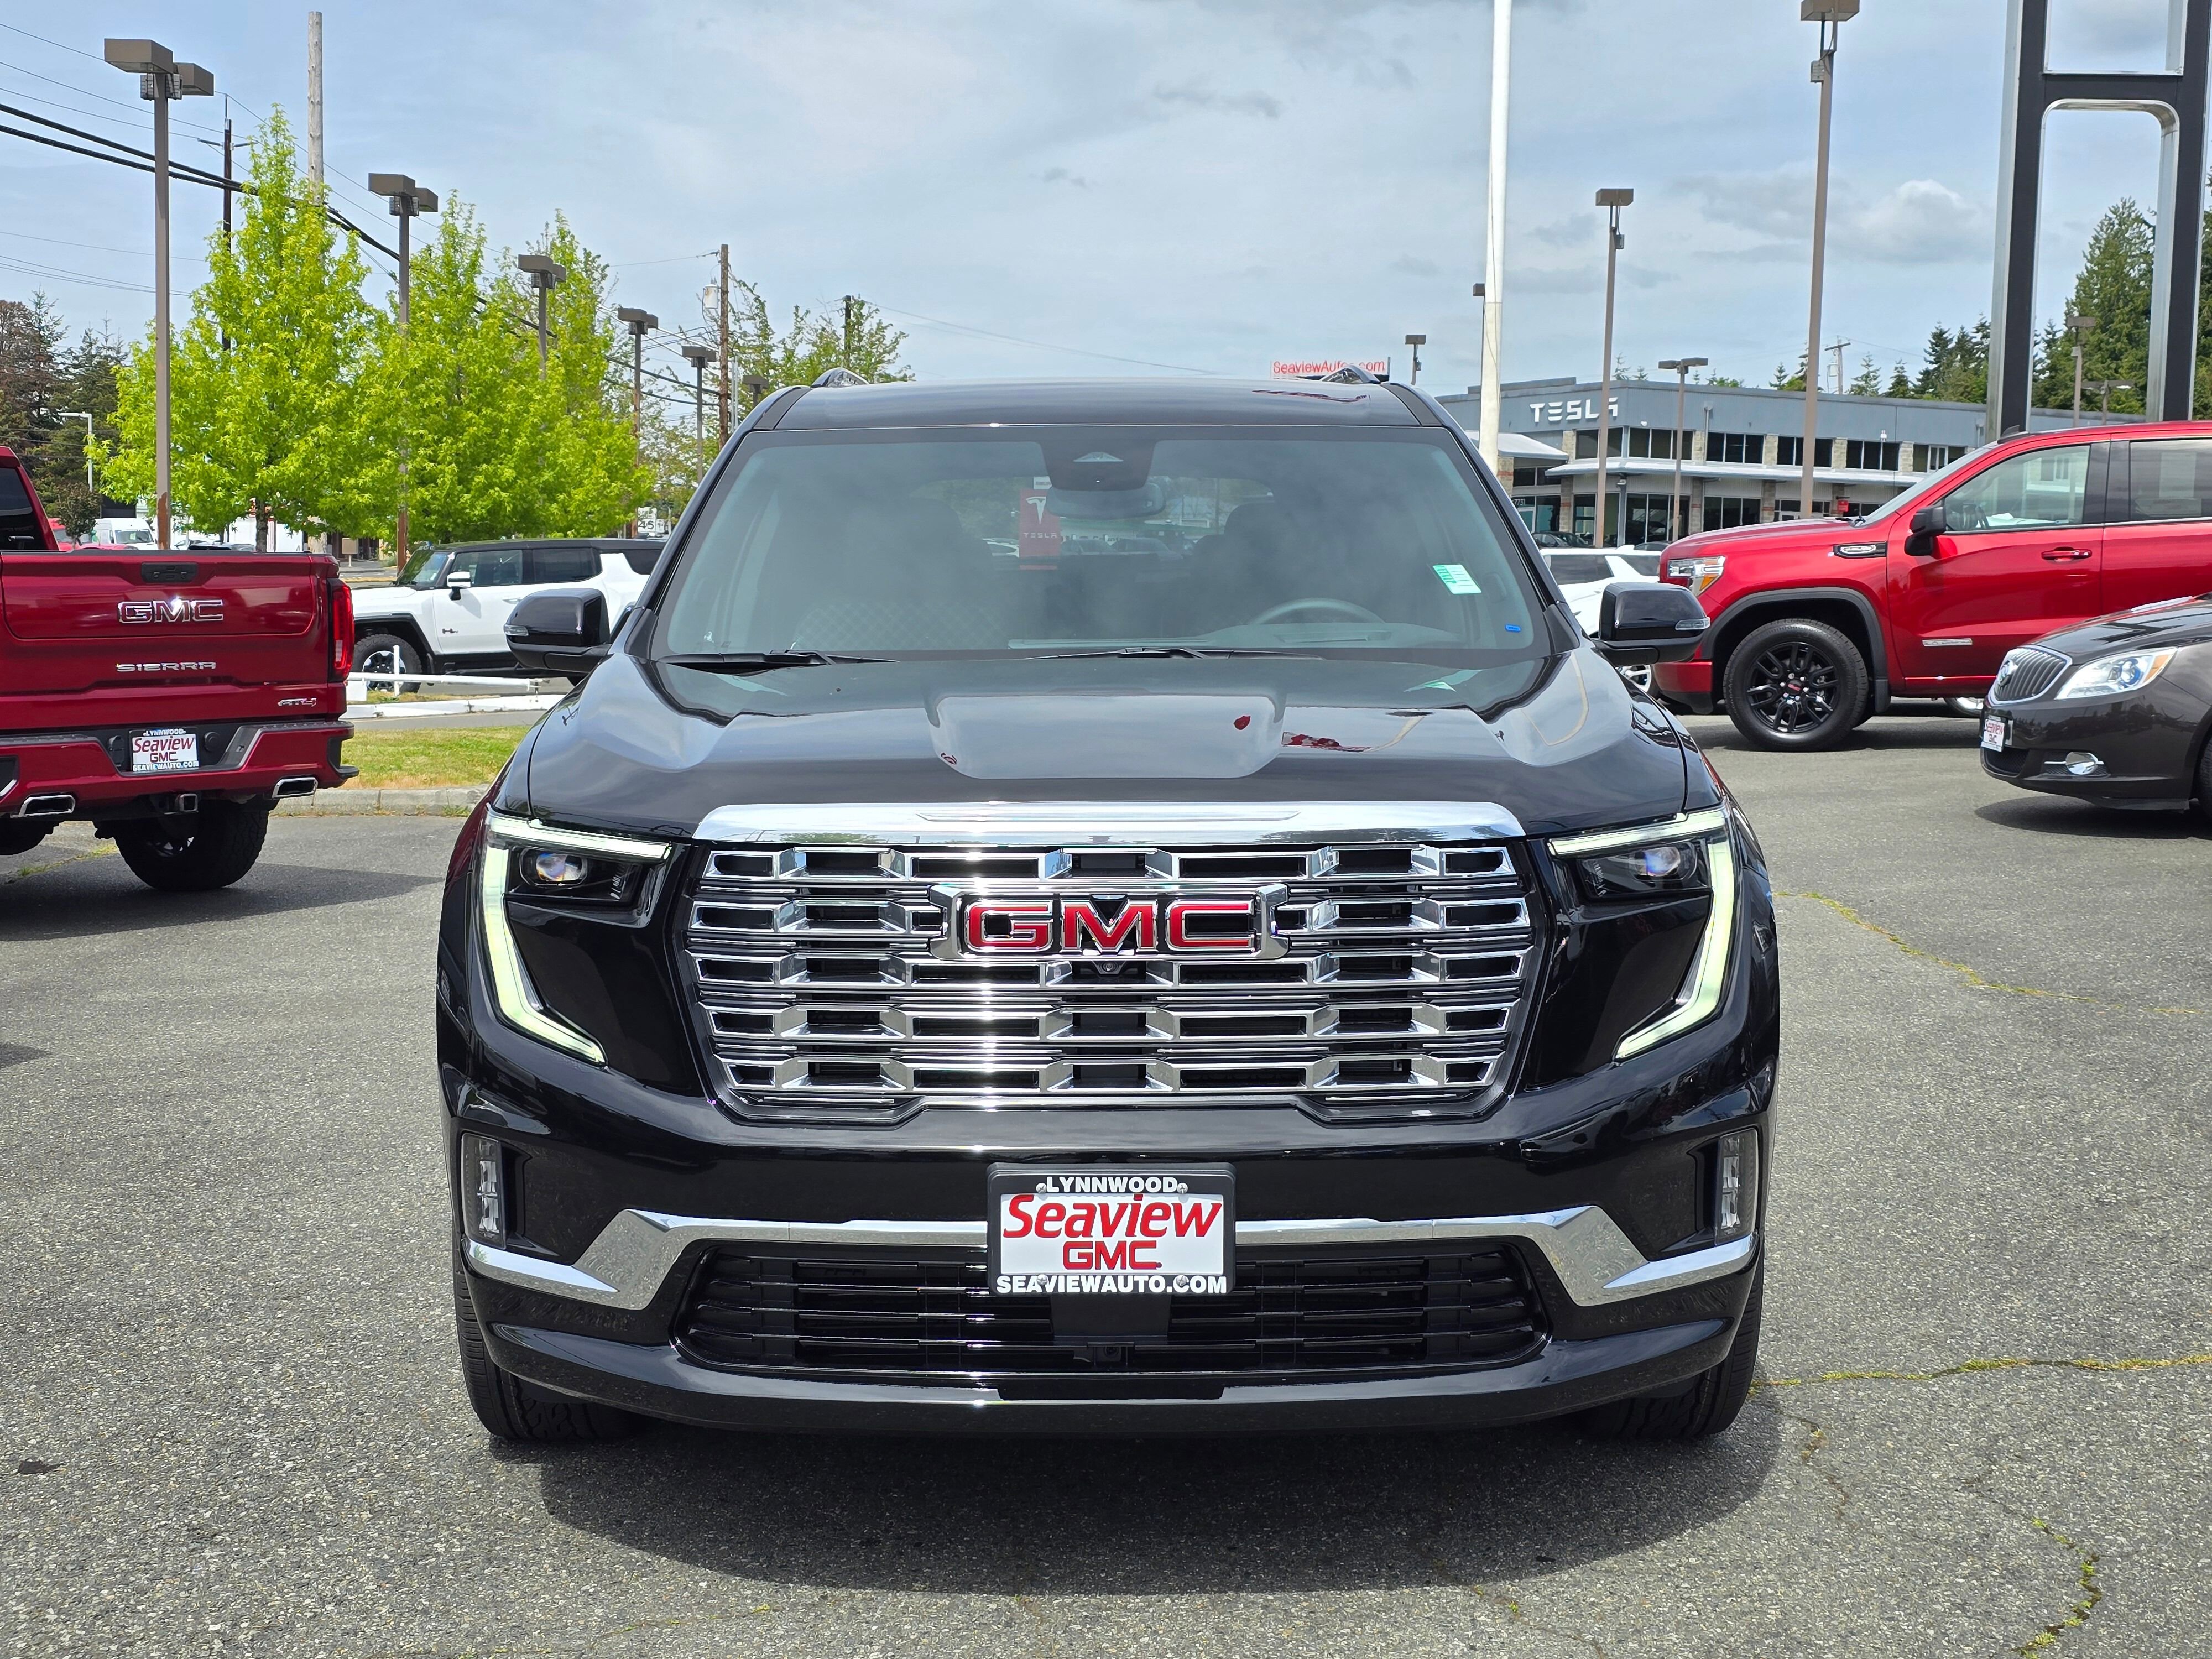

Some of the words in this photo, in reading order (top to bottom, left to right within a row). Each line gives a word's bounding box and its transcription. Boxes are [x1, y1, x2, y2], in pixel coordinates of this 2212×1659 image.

[1530, 397, 1618, 422] TESLA
[638, 520, 654, 529] 45
[118, 599, 223, 623] GMC
[116, 662, 216, 672] SIERRA
[133, 736, 195, 753] Seaview
[133, 761, 199, 771] SEAVIEWAUTO.COM
[150, 752, 178, 763] GMC
[966, 899, 1256, 953] GMC
[1047, 1176, 1178, 1193] LYNNWOOD
[1003, 1194, 1222, 1238] Seaview
[1063, 1240, 1158, 1270] GMC
[997, 1275, 1227, 1293] SEAVIEWAUTO.COM
